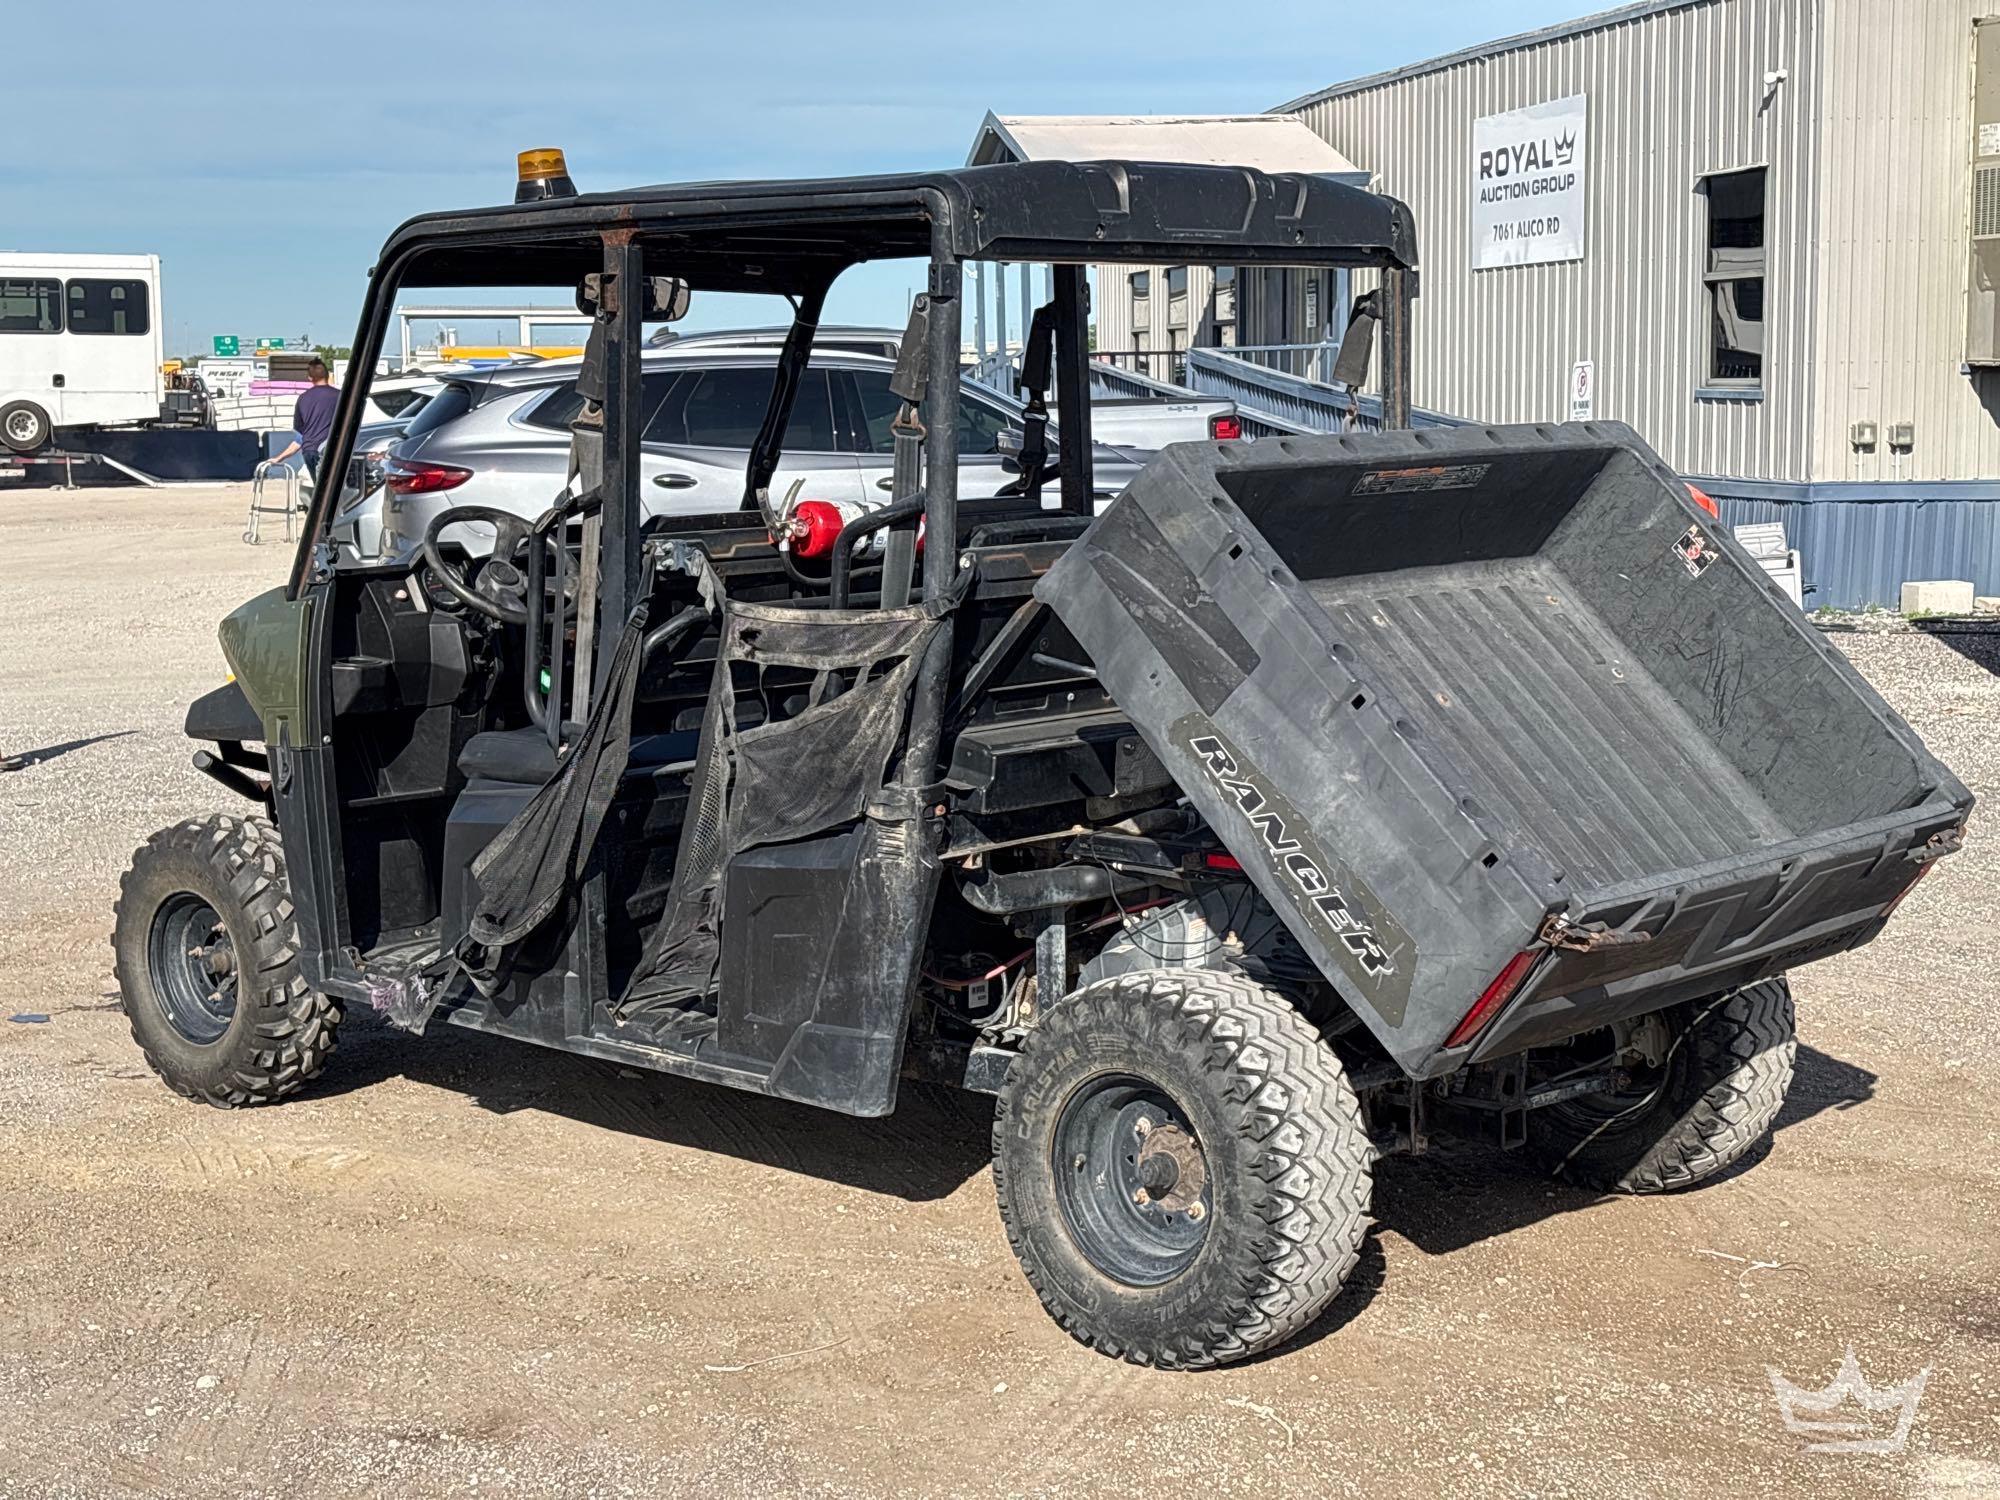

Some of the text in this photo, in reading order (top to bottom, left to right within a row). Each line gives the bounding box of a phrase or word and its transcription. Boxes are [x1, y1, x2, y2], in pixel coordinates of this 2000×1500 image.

[1480, 139, 1553, 180] ROYAL
[1480, 173, 1575, 204] AUCTION GROUP
[1493, 216, 1560, 242] 7061 ALICO RD
[1189, 735, 1394, 977] RANGER
